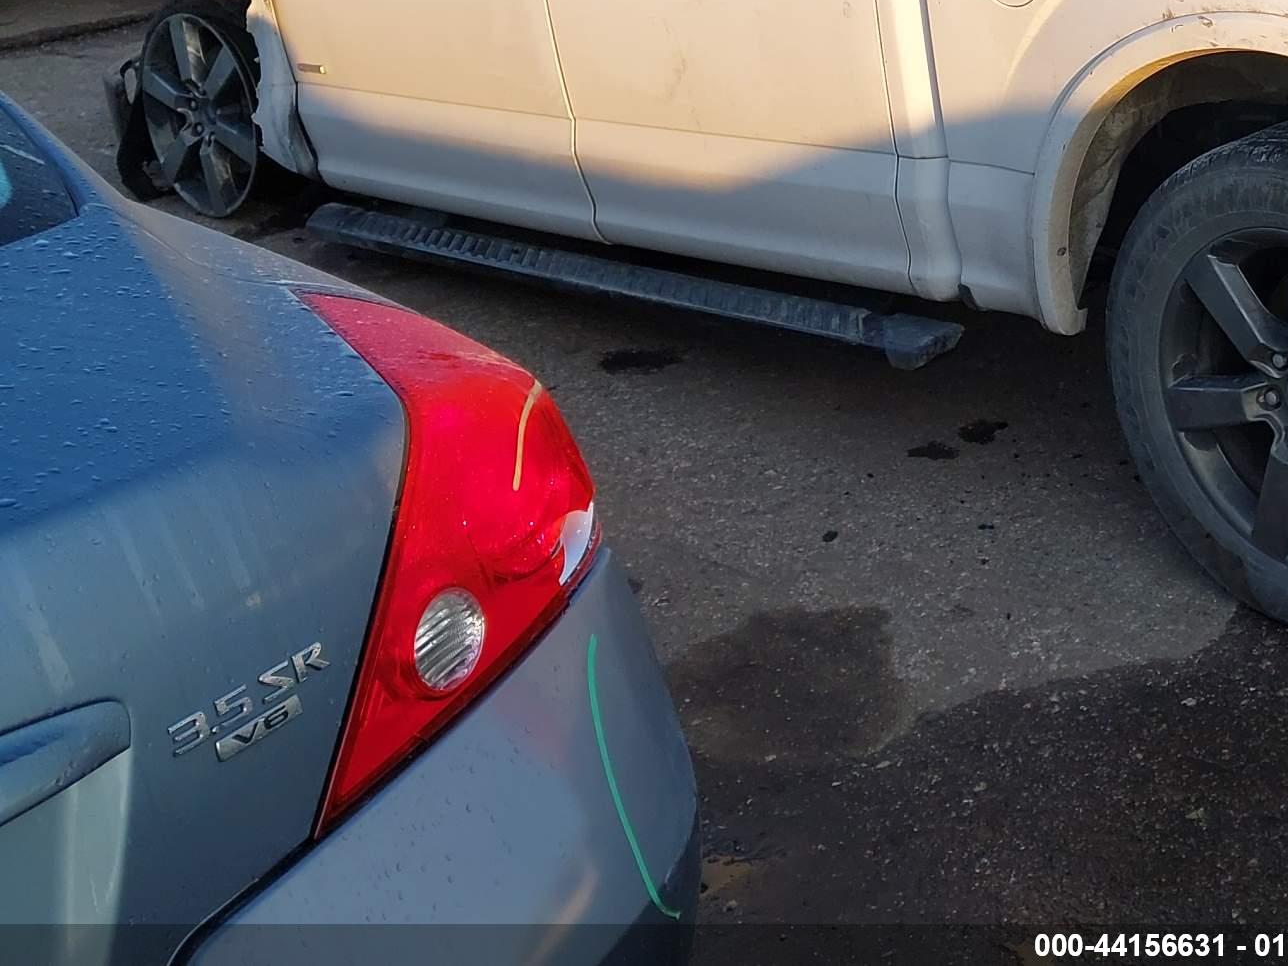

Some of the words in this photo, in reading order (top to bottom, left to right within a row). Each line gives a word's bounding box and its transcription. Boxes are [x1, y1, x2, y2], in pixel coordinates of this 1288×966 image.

[167, 683, 253, 758] 3.5
[257, 641, 331, 705] SR
[232, 704, 290, 745] V6
